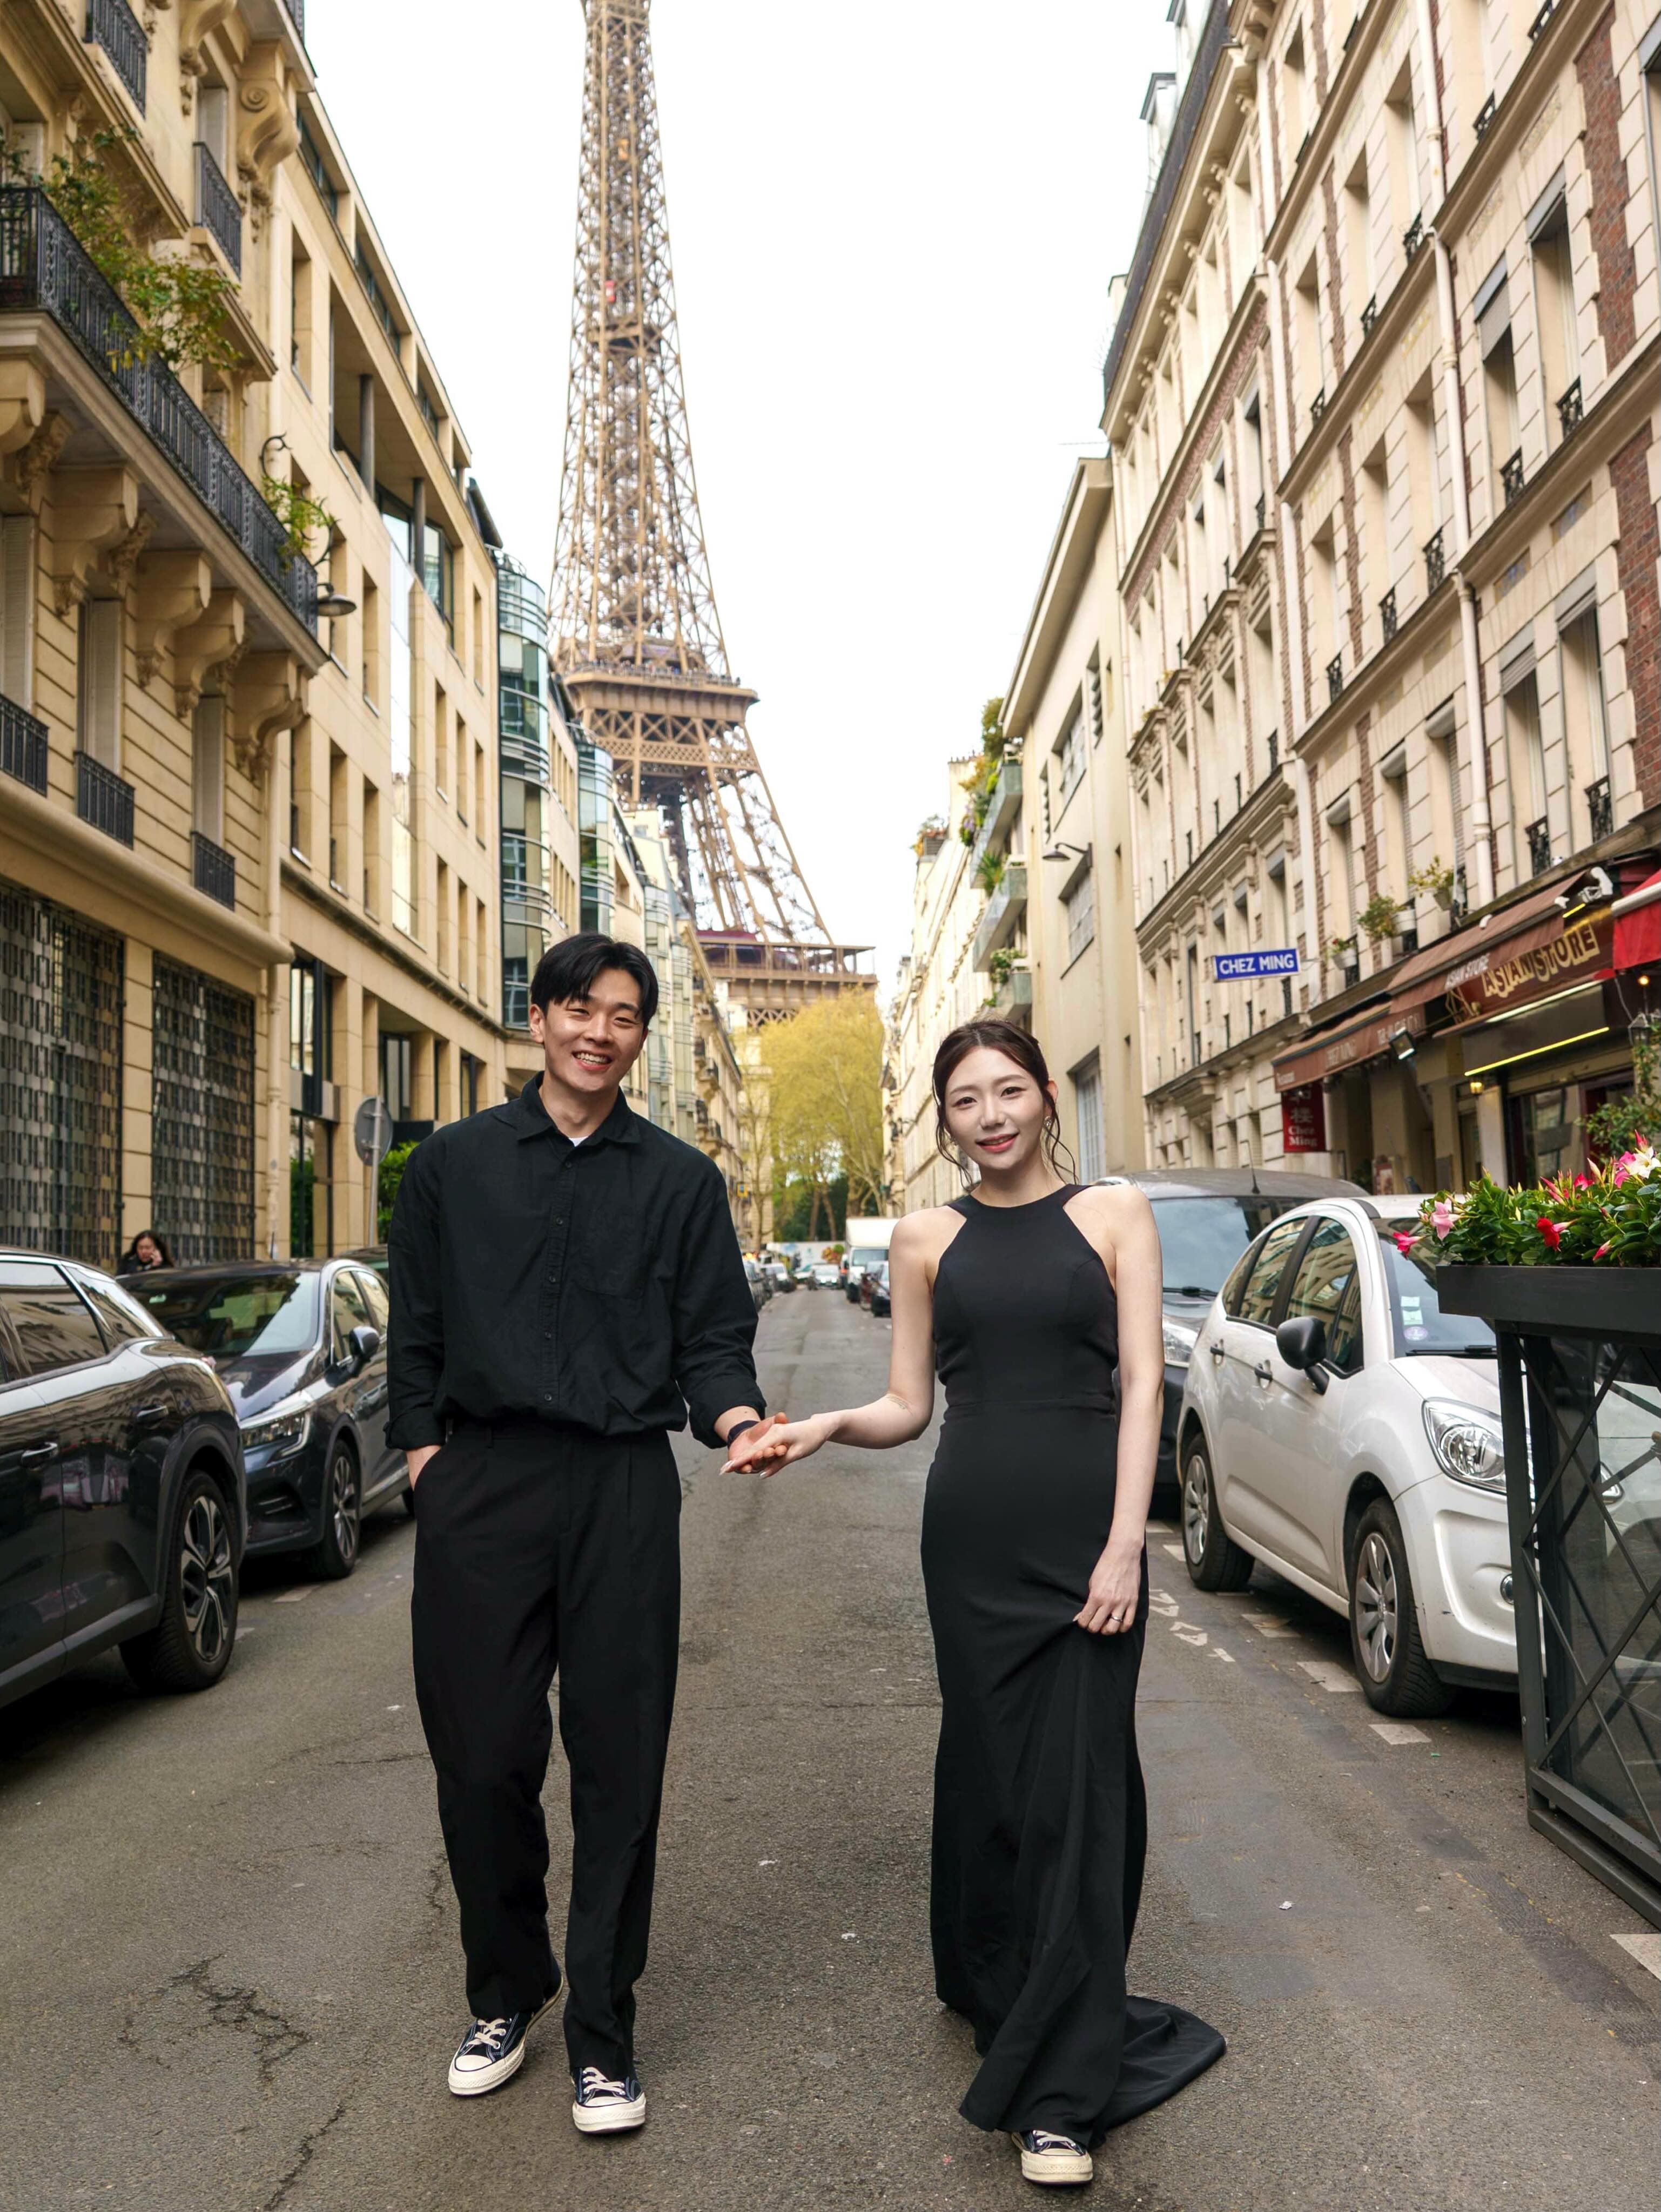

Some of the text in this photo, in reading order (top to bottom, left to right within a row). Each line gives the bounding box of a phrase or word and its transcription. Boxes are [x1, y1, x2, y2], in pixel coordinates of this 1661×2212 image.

[1219, 954, 1294, 974] CHEZ MING
[1481, 923, 1600, 997] ASIAN STORE
[1288, 1125, 1315, 1135] Chez
[1289, 1135, 1317, 1147] Ming
